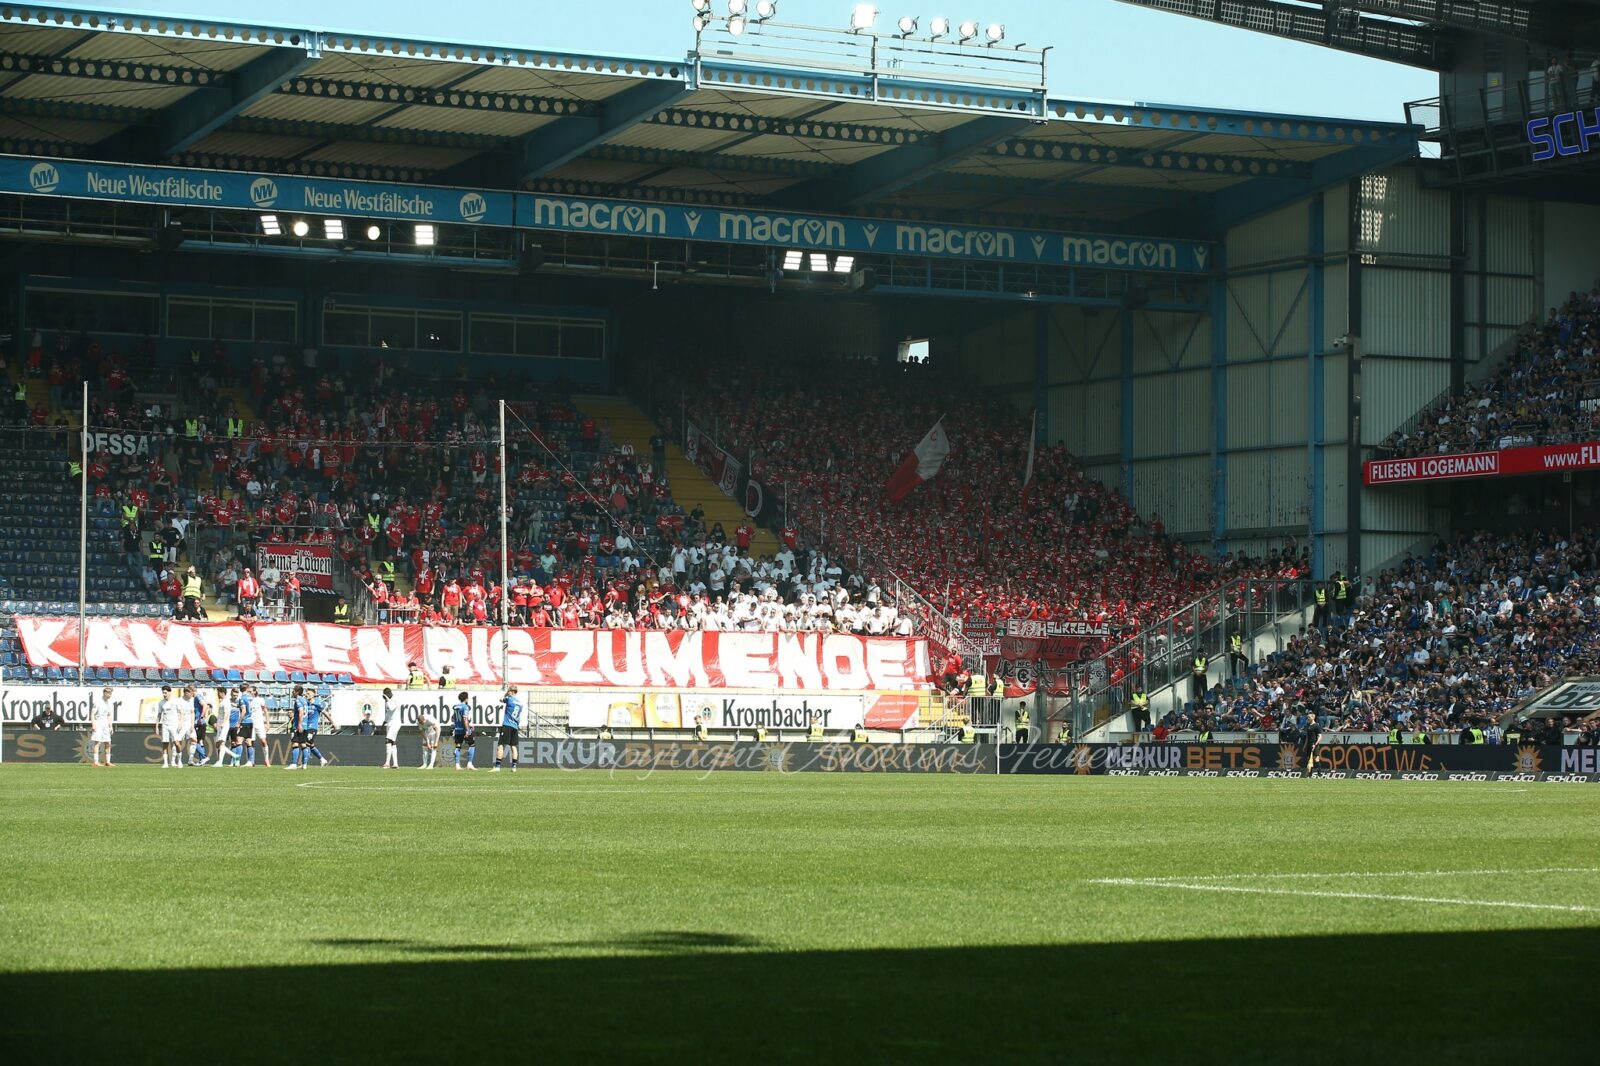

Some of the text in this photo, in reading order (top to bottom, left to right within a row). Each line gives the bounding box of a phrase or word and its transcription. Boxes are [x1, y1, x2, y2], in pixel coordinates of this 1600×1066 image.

[33, 168, 57, 186] NW
[87, 172, 223, 200] Neue Westfälische
[254, 183, 275, 200] NW
[304, 186, 433, 215] Neue Westfälische
[463, 198, 484, 215] NW
[534, 198, 667, 234] macron
[719, 213, 845, 246] macron
[896, 224, 1015, 257] macron
[1062, 236, 1176, 268] macron
[80, 432, 158, 455] DESSA
[1372, 455, 1496, 479] FLIESEN LOGEMANN
[422, 626, 541, 684] BIS
[550, 630, 704, 688] ZUM
[717, 631, 929, 690] ENDE!
[722, 698, 832, 728] Krombacher
[624, 743, 736, 767] BETS
[1105, 747, 1261, 768] MERKUR BETS
[1108, 768, 1140, 777] SCHÜCO
[1148, 769, 1179, 777] SCHÜCO
[1187, 769, 1218, 777] SCHÜCO
[1226, 769, 1259, 778] SCHÜCO
[1267, 769, 1301, 778] SCHÜCO
[1355, 771, 1392, 781] SCHÜCO
[1401, 771, 1438, 781] SCHÜCO
[1448, 771, 1487, 782] SCHÜCO
[1497, 773, 1536, 783] SCHÜCO
[1546, 773, 1588, 783] SCHÜCO
